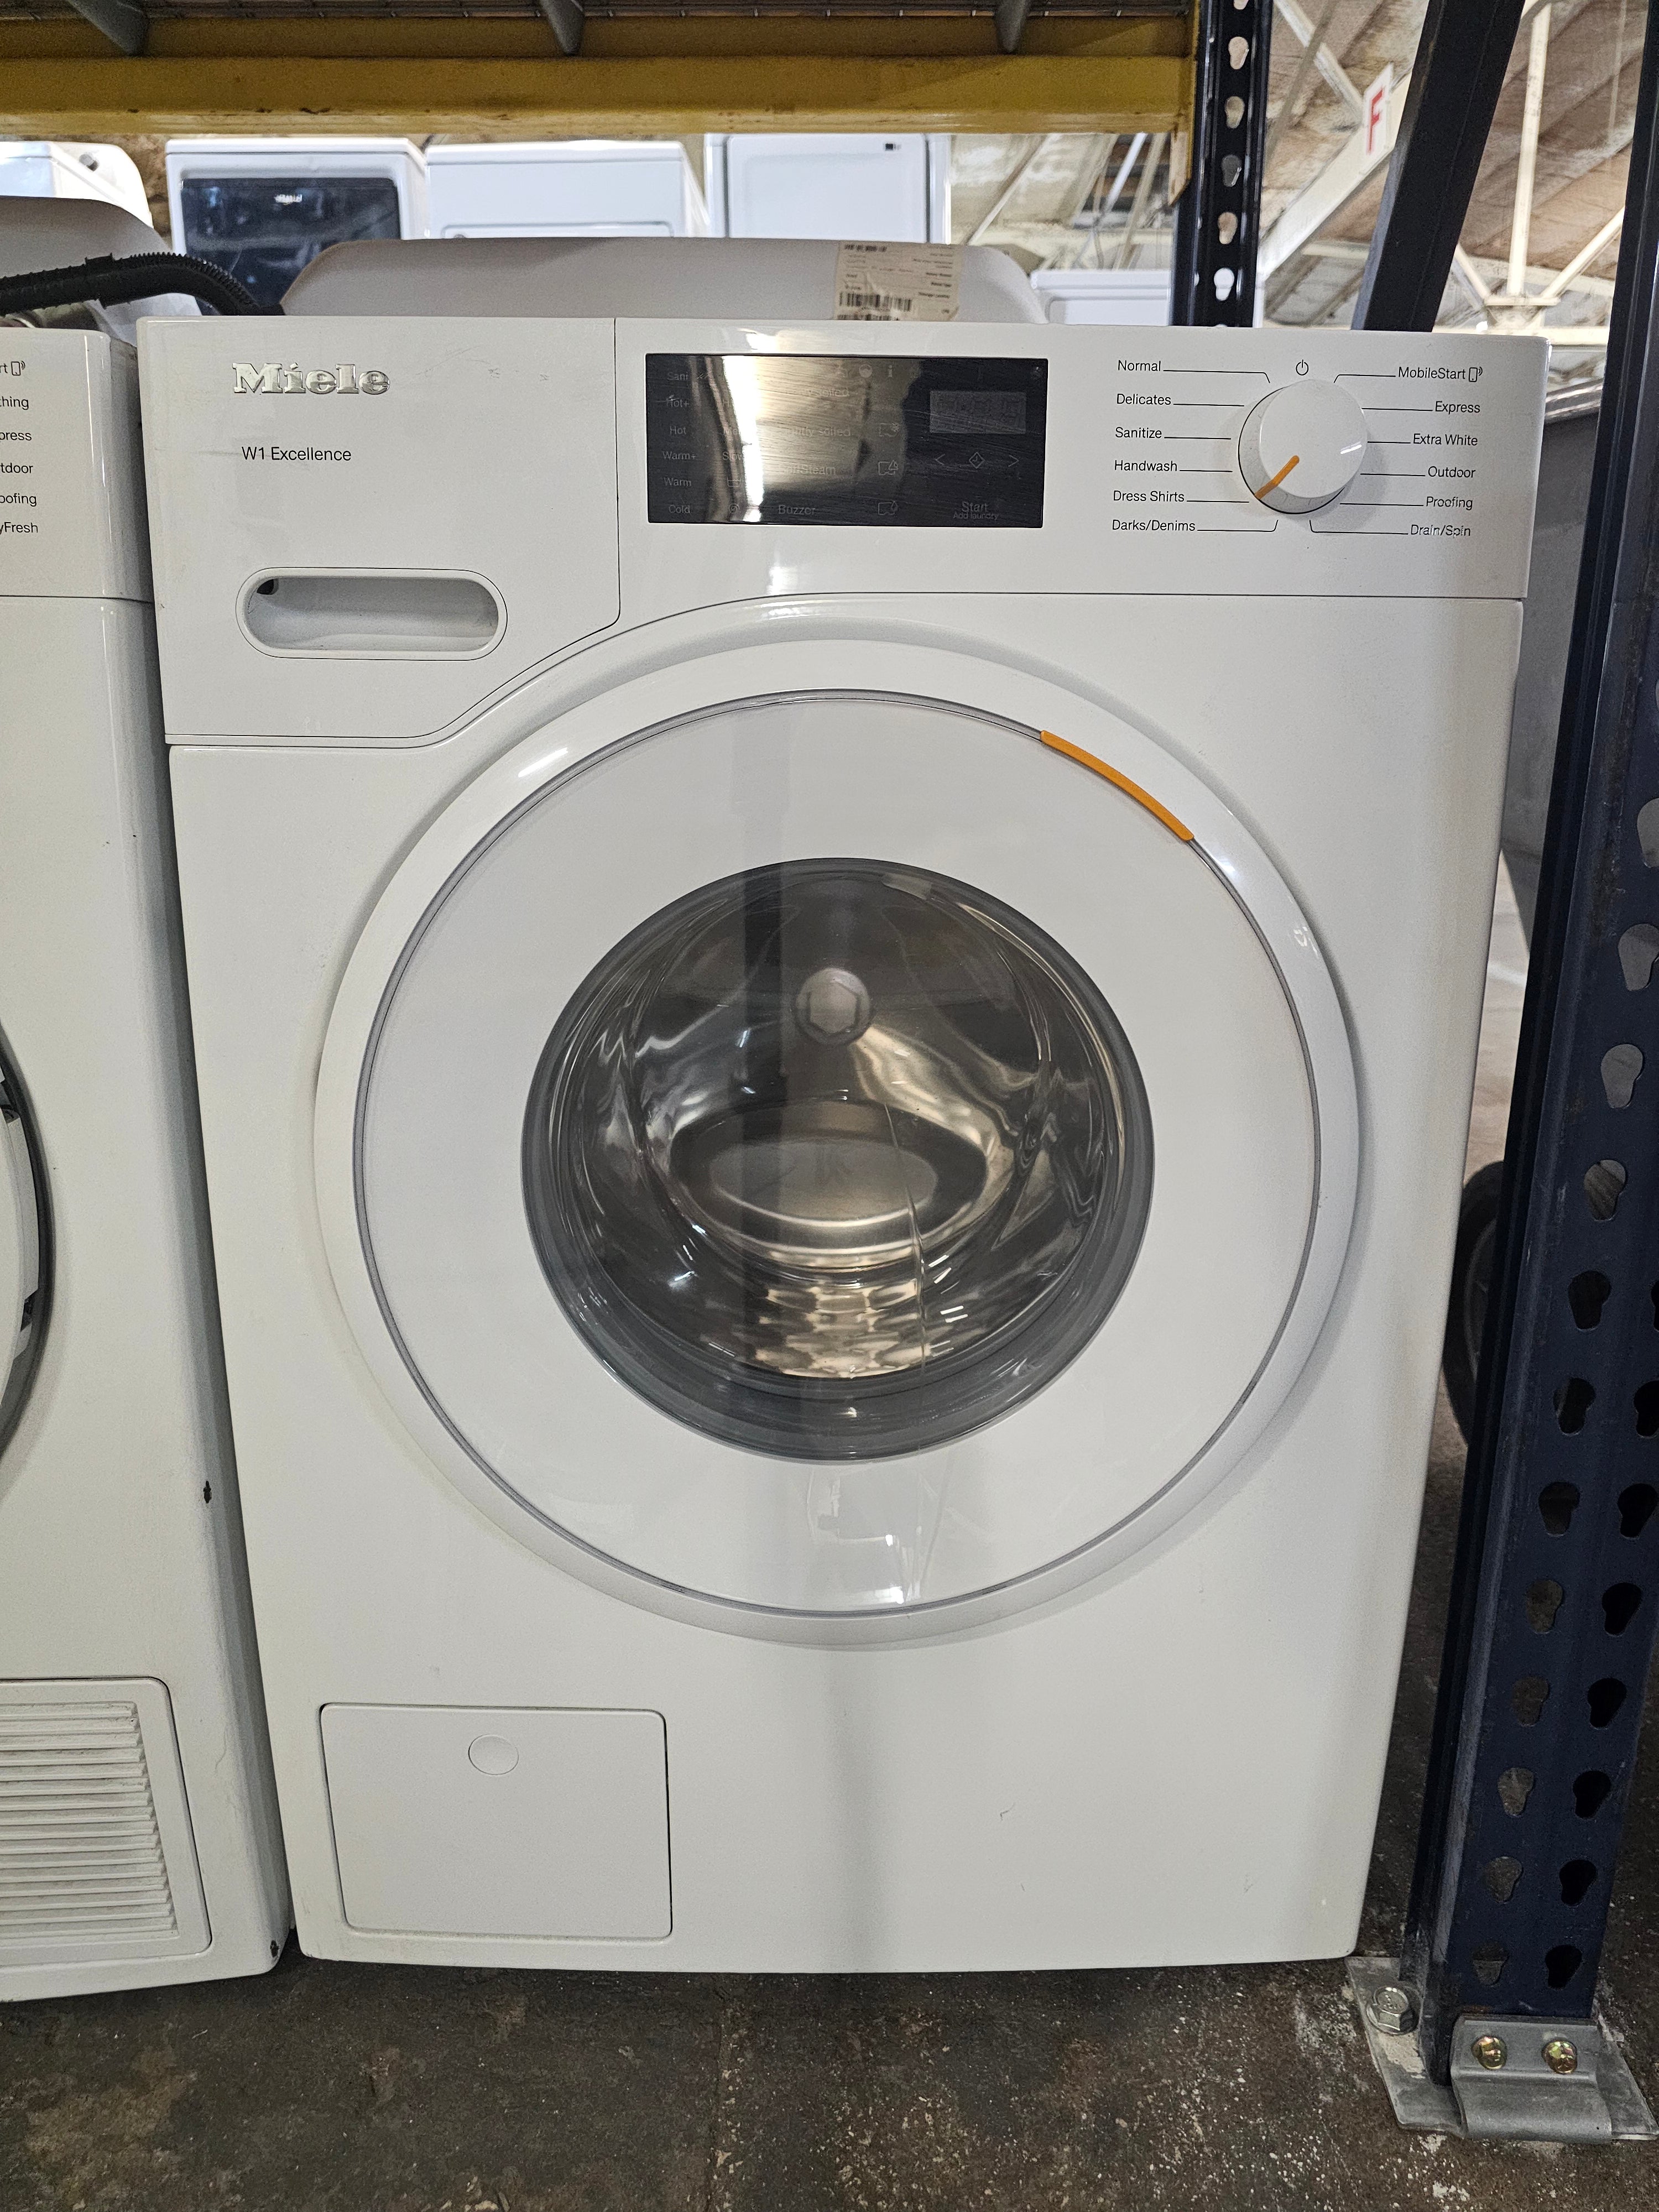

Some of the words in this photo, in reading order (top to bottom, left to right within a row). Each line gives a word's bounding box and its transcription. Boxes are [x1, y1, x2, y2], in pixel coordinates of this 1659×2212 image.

[1368, 86, 1385, 154] F
[1118, 359, 1161, 372] Normal
[232, 362, 390, 395] Miele
[666, 372, 688, 381] Sani
[1399, 366, 1466, 379] MobileStart
[1117, 393, 1171, 405] Delicates
[1435, 400, 1480, 415] Express
[670, 425, 687, 435] Hot
[1115, 426, 1162, 439] Sanitize
[1413, 433, 1442, 445] Extra
[1444, 434, 1478, 446] White
[241, 446, 265, 460] W1
[270, 446, 352, 461] Excellence
[662, 450, 697, 460] Warm+
[1114, 460, 1177, 472] Handwash
[1428, 466, 1476, 478] Outdoor
[663, 477, 692, 487] Warm
[1113, 490, 1147, 502] Dress
[1150, 490, 1185, 502] Shirts
[668, 504, 691, 514] Cold
[778, 504, 816, 515] Buzzer
[961, 501, 989, 513] Start
[1426, 496, 1473, 511] Proofing
[1112, 519, 1196, 531] Darks/Denims
[1411, 524, 1471, 539] Drain/Spin
